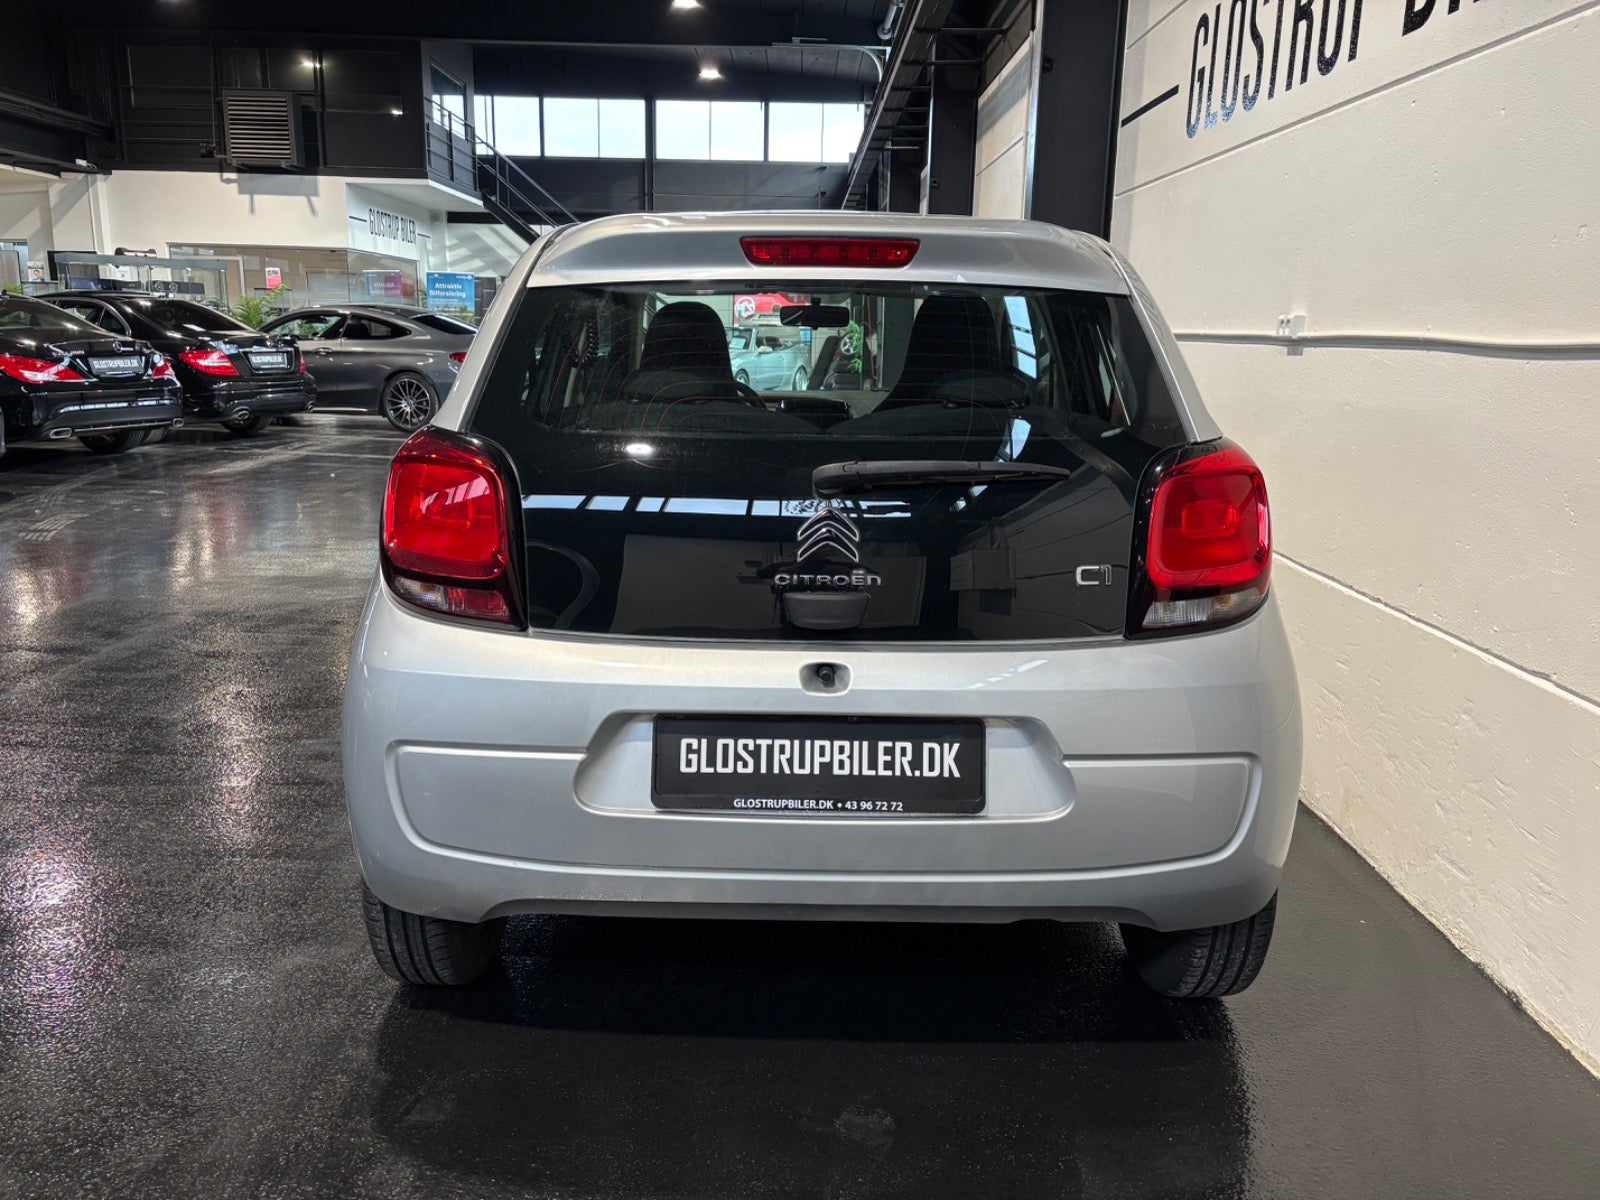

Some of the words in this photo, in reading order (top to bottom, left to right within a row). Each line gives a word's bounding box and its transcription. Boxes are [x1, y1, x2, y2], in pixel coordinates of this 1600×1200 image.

[369, 208, 399, 240] GLOSTRUP
[400, 217, 416, 244] BILER
[435, 282, 463, 290] Attraktiv
[1076, 565, 1112, 586] C1
[679, 737, 961, 778] GLOSTRUPBILER.DK
[733, 798, 833, 810] GLOSTRUPBILER.DK
[844, 801, 858, 811] 43
[860, 801, 873, 811] 96
[875, 801, 888, 811] 72
[890, 802, 903, 812] 72
